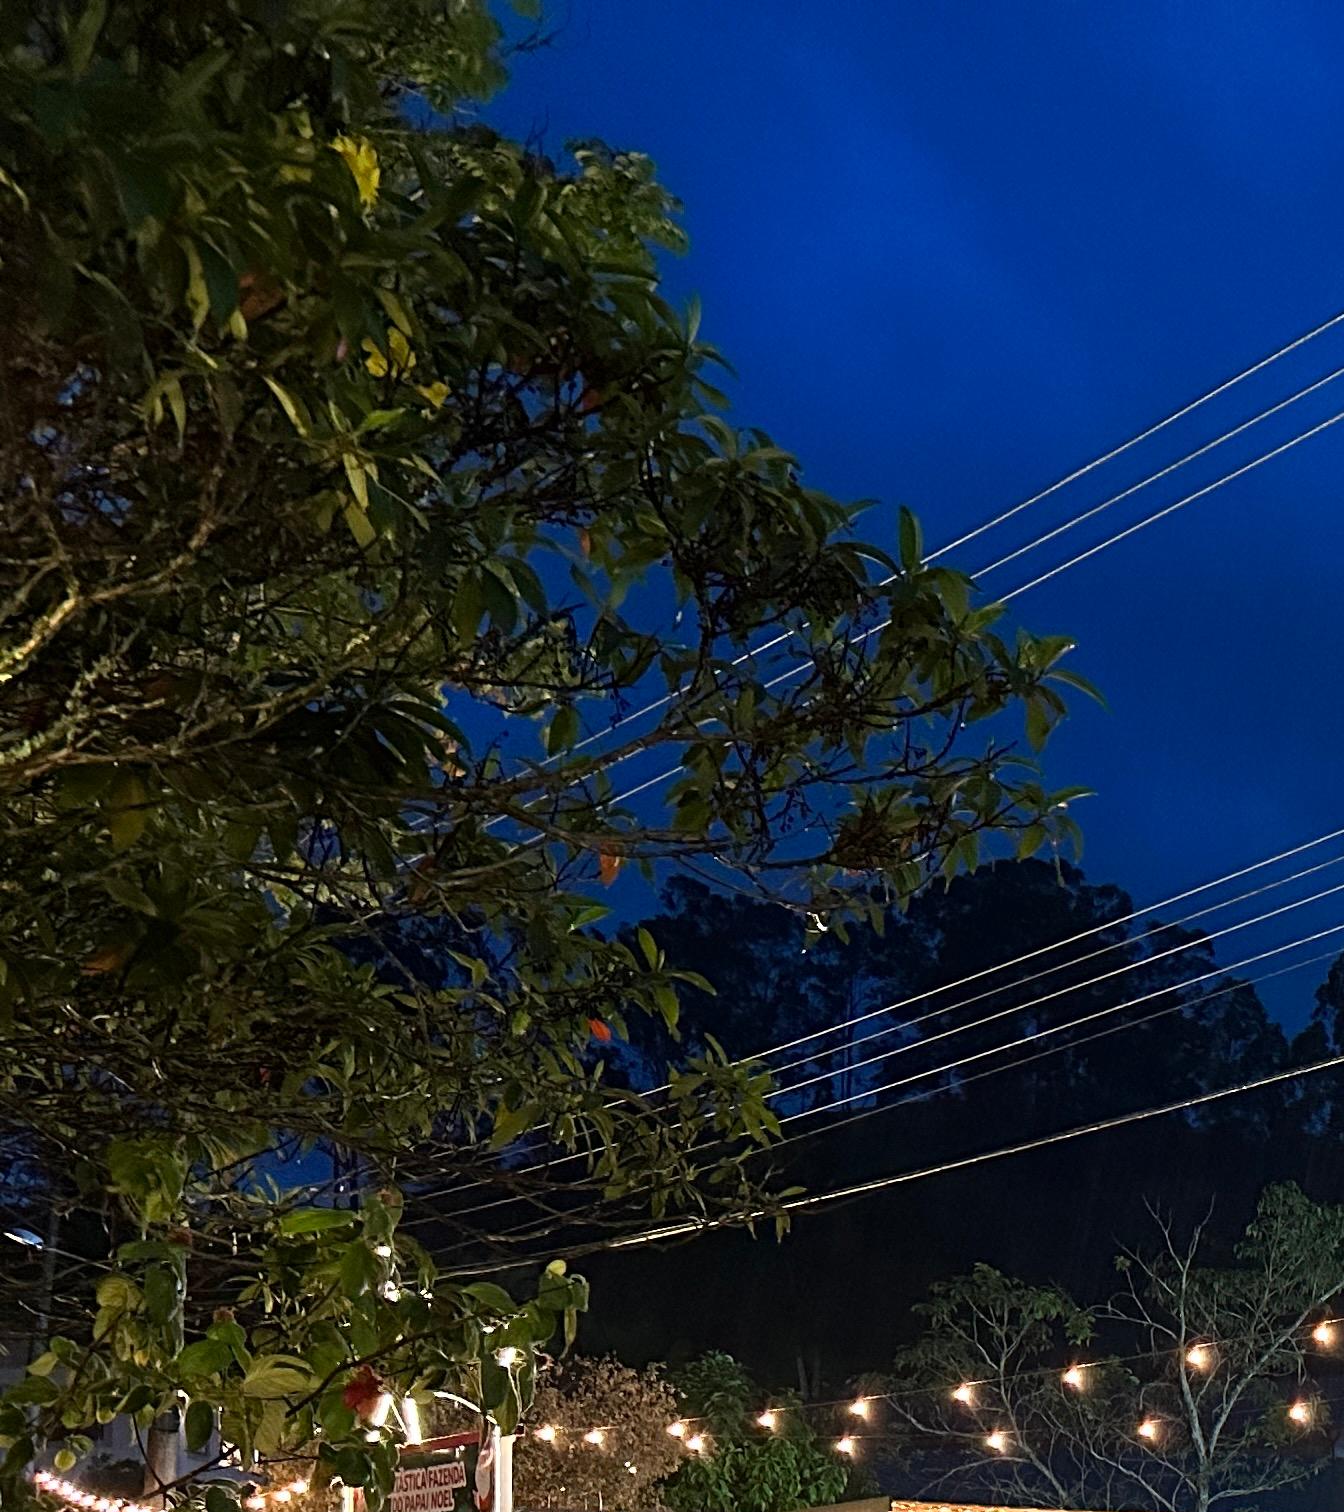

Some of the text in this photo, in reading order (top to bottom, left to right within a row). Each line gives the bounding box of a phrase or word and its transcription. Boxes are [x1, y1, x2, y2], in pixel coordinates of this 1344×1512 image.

[394, 1465, 465, 1493] TÁSTICA FAZENDA
[404, 1493, 428, 1512] PAPAI
[430, 1489, 453, 1509] NOEL
